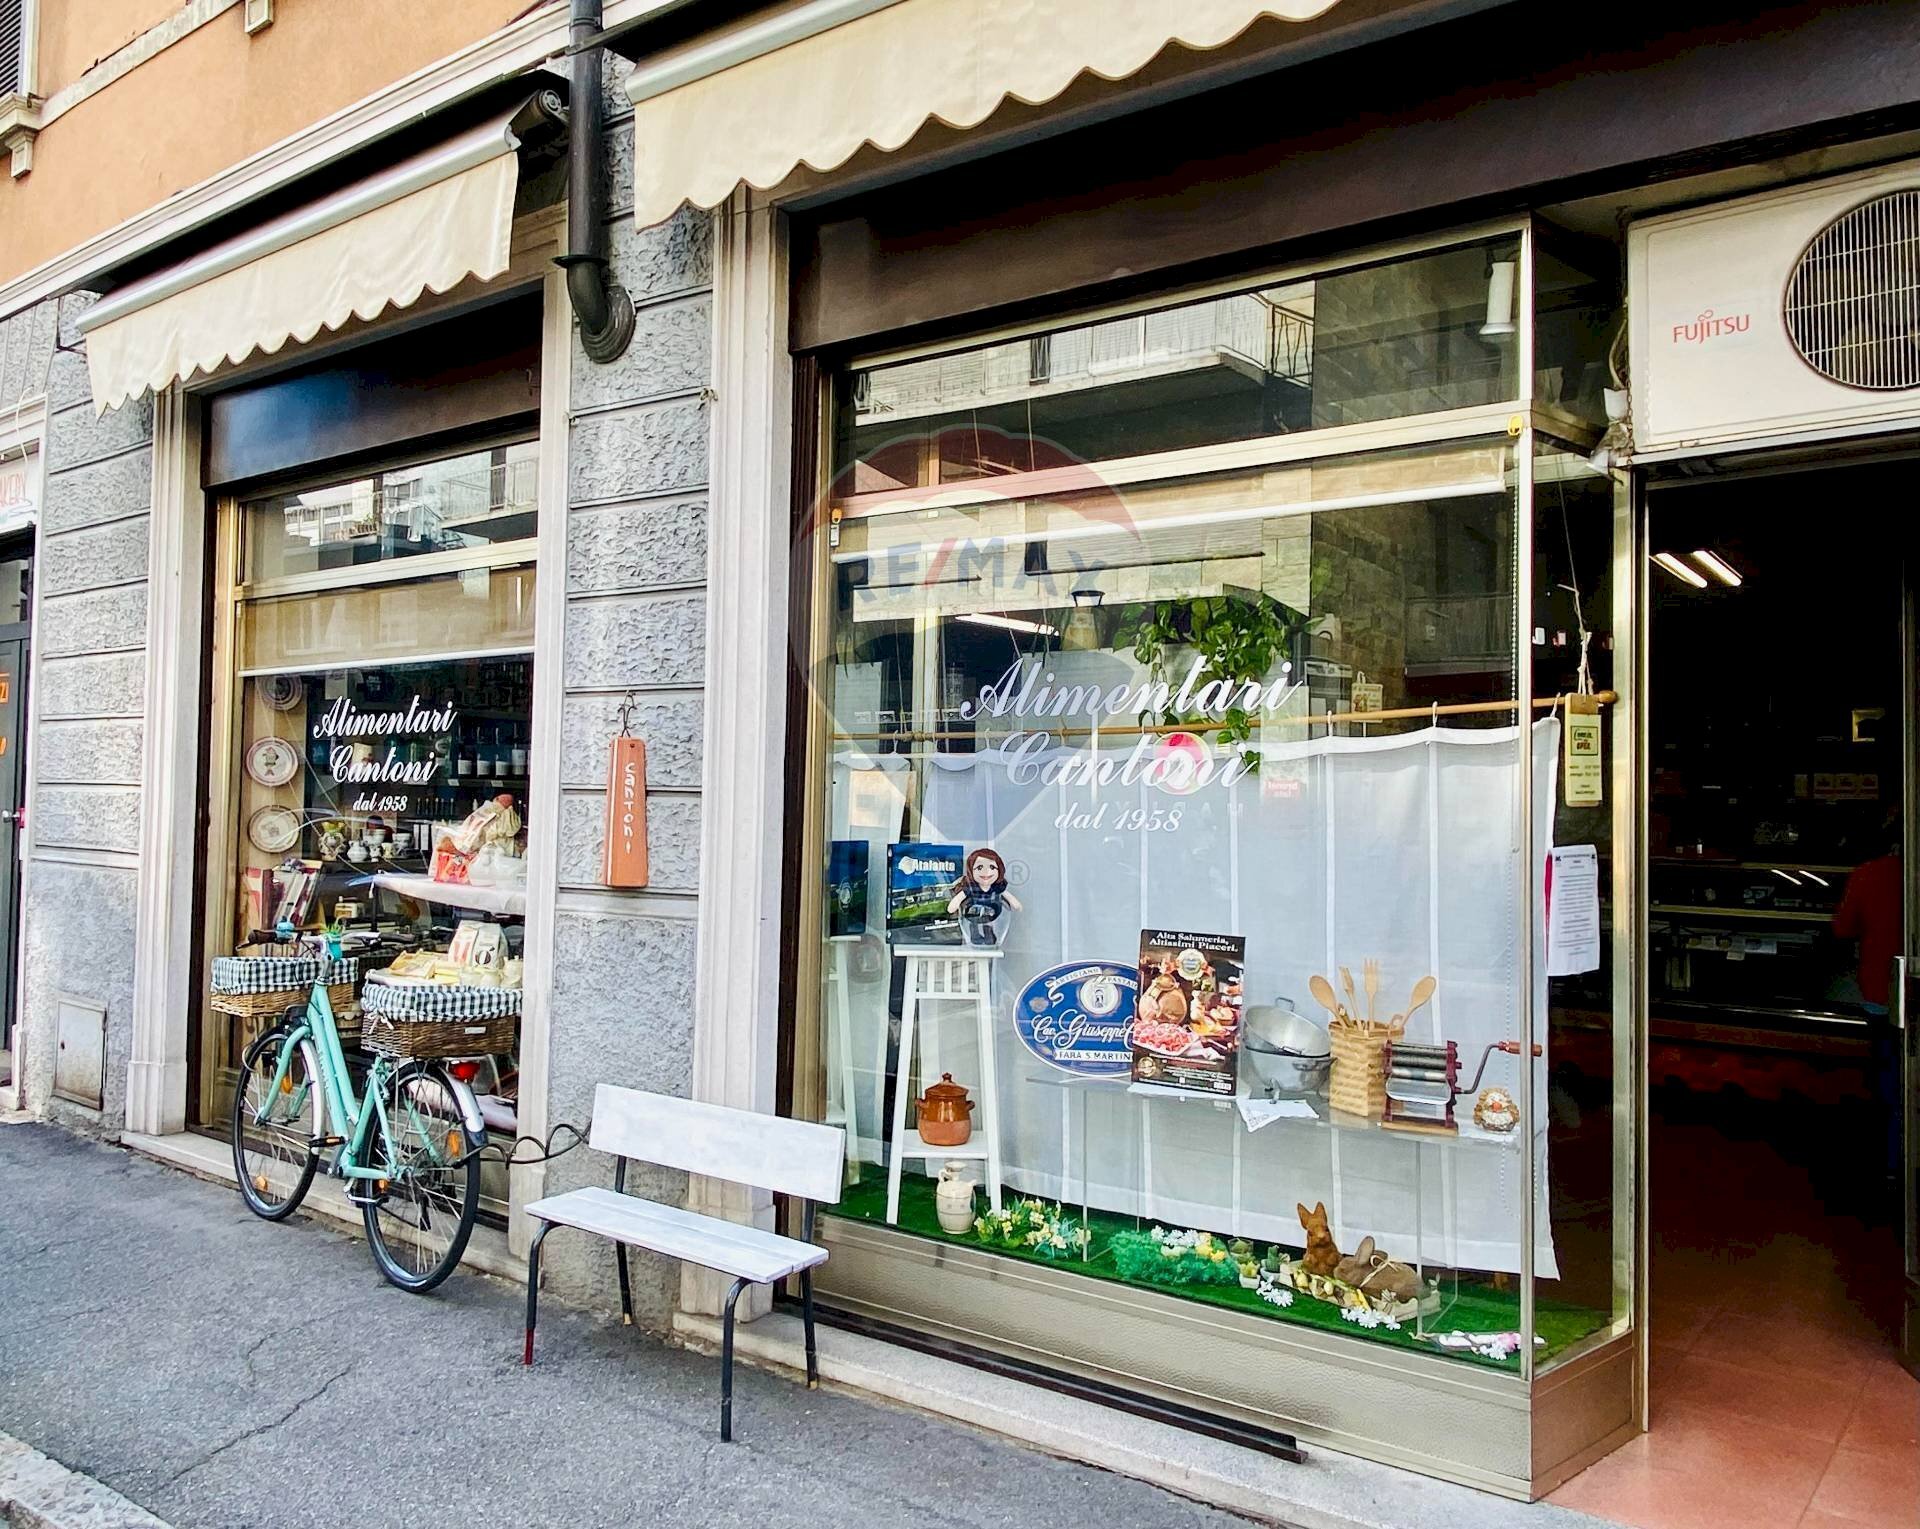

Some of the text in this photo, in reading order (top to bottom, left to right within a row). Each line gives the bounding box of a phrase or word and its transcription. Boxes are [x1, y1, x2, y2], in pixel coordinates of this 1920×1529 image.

[1673, 309, 1750, 344] FUJITSU
[961, 655, 1304, 720] Alimentari
[313, 694, 458, 739] Alimentari
[329, 744, 439, 783] Cantoni
[999, 731, 1258, 788] Cantoni
[352, 792, 408, 811] dal 1958
[1054, 802, 1183, 832] dal 1958
[912, 858, 956, 873] Atalanta
[1149, 938, 1195, 949] Altissimi
[1156, 931, 1176, 940] Alta
[1059, 1051, 1082, 1059] FARA
[1094, 1052, 1132, 1061] MARTIN
